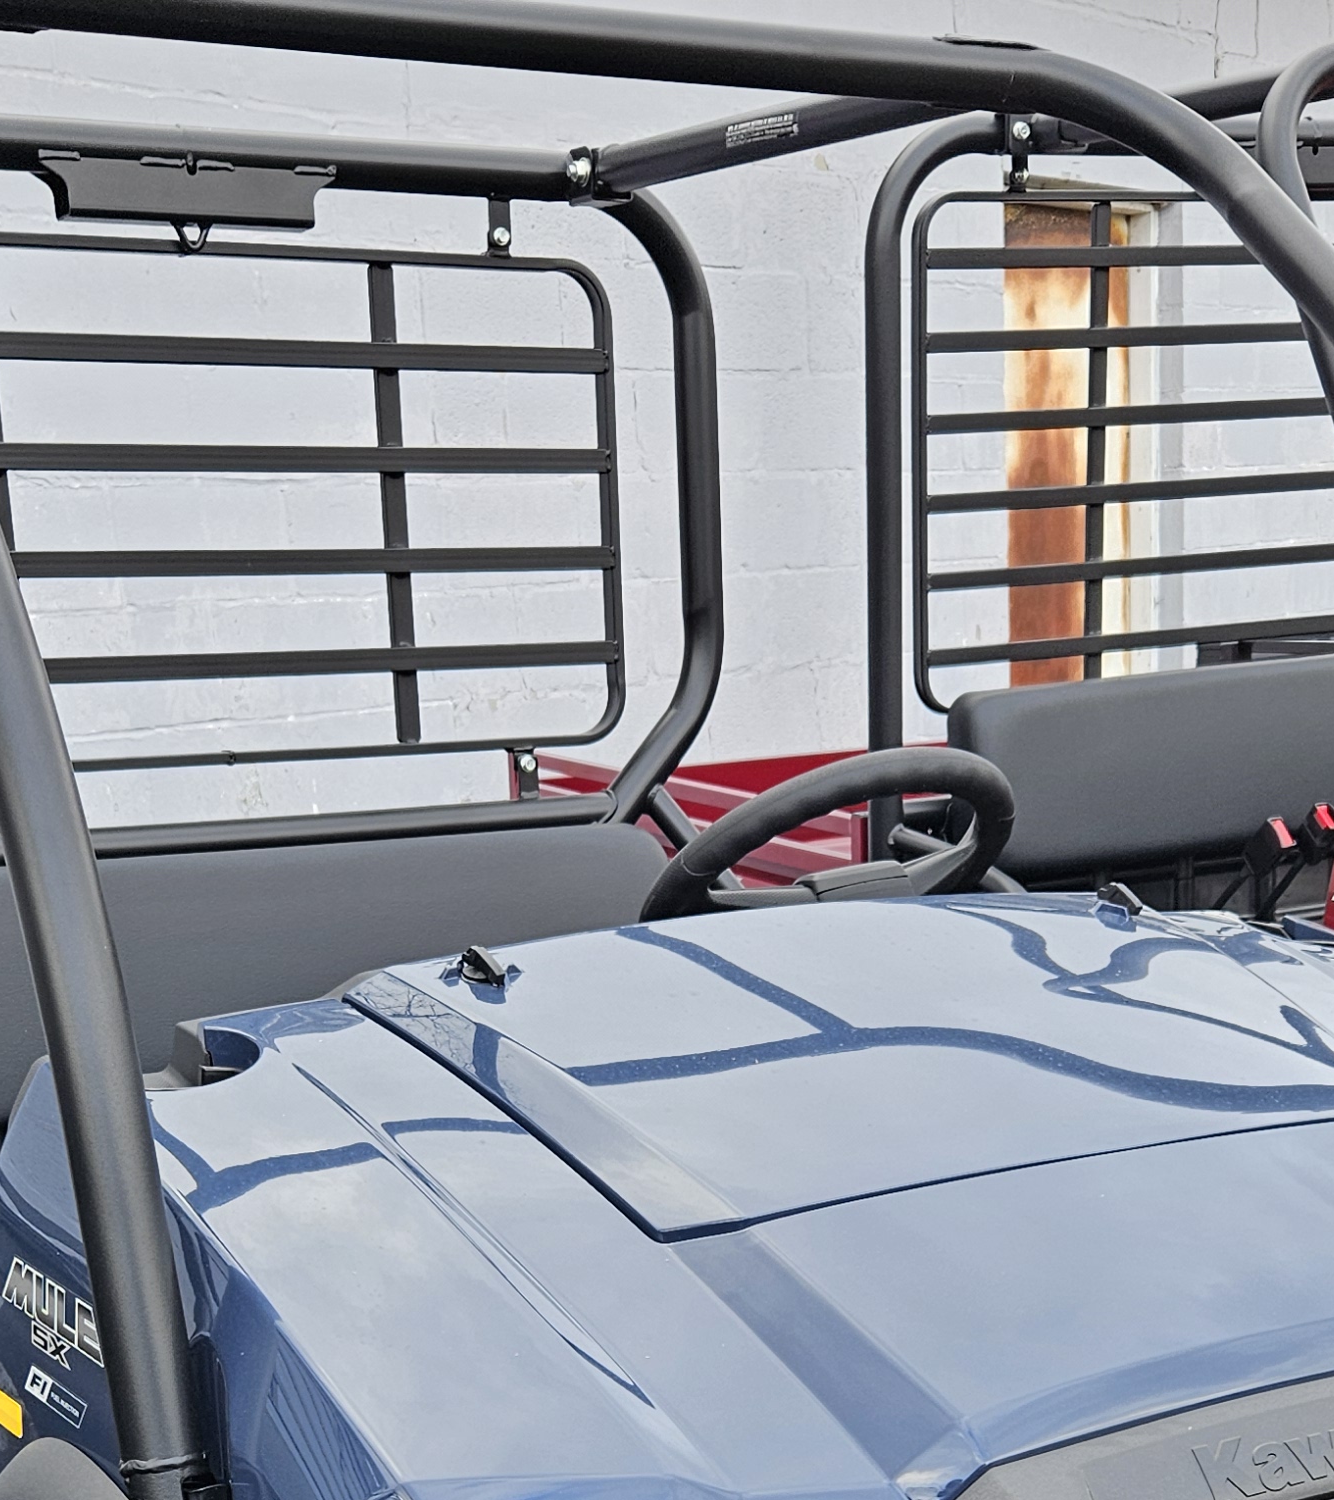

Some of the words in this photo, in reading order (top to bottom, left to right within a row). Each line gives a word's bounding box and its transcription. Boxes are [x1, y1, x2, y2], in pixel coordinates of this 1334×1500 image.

[2, 1255, 105, 1368] MULE
[31, 1320, 71, 1371] SX
[29, 1373, 49, 1395] FI
